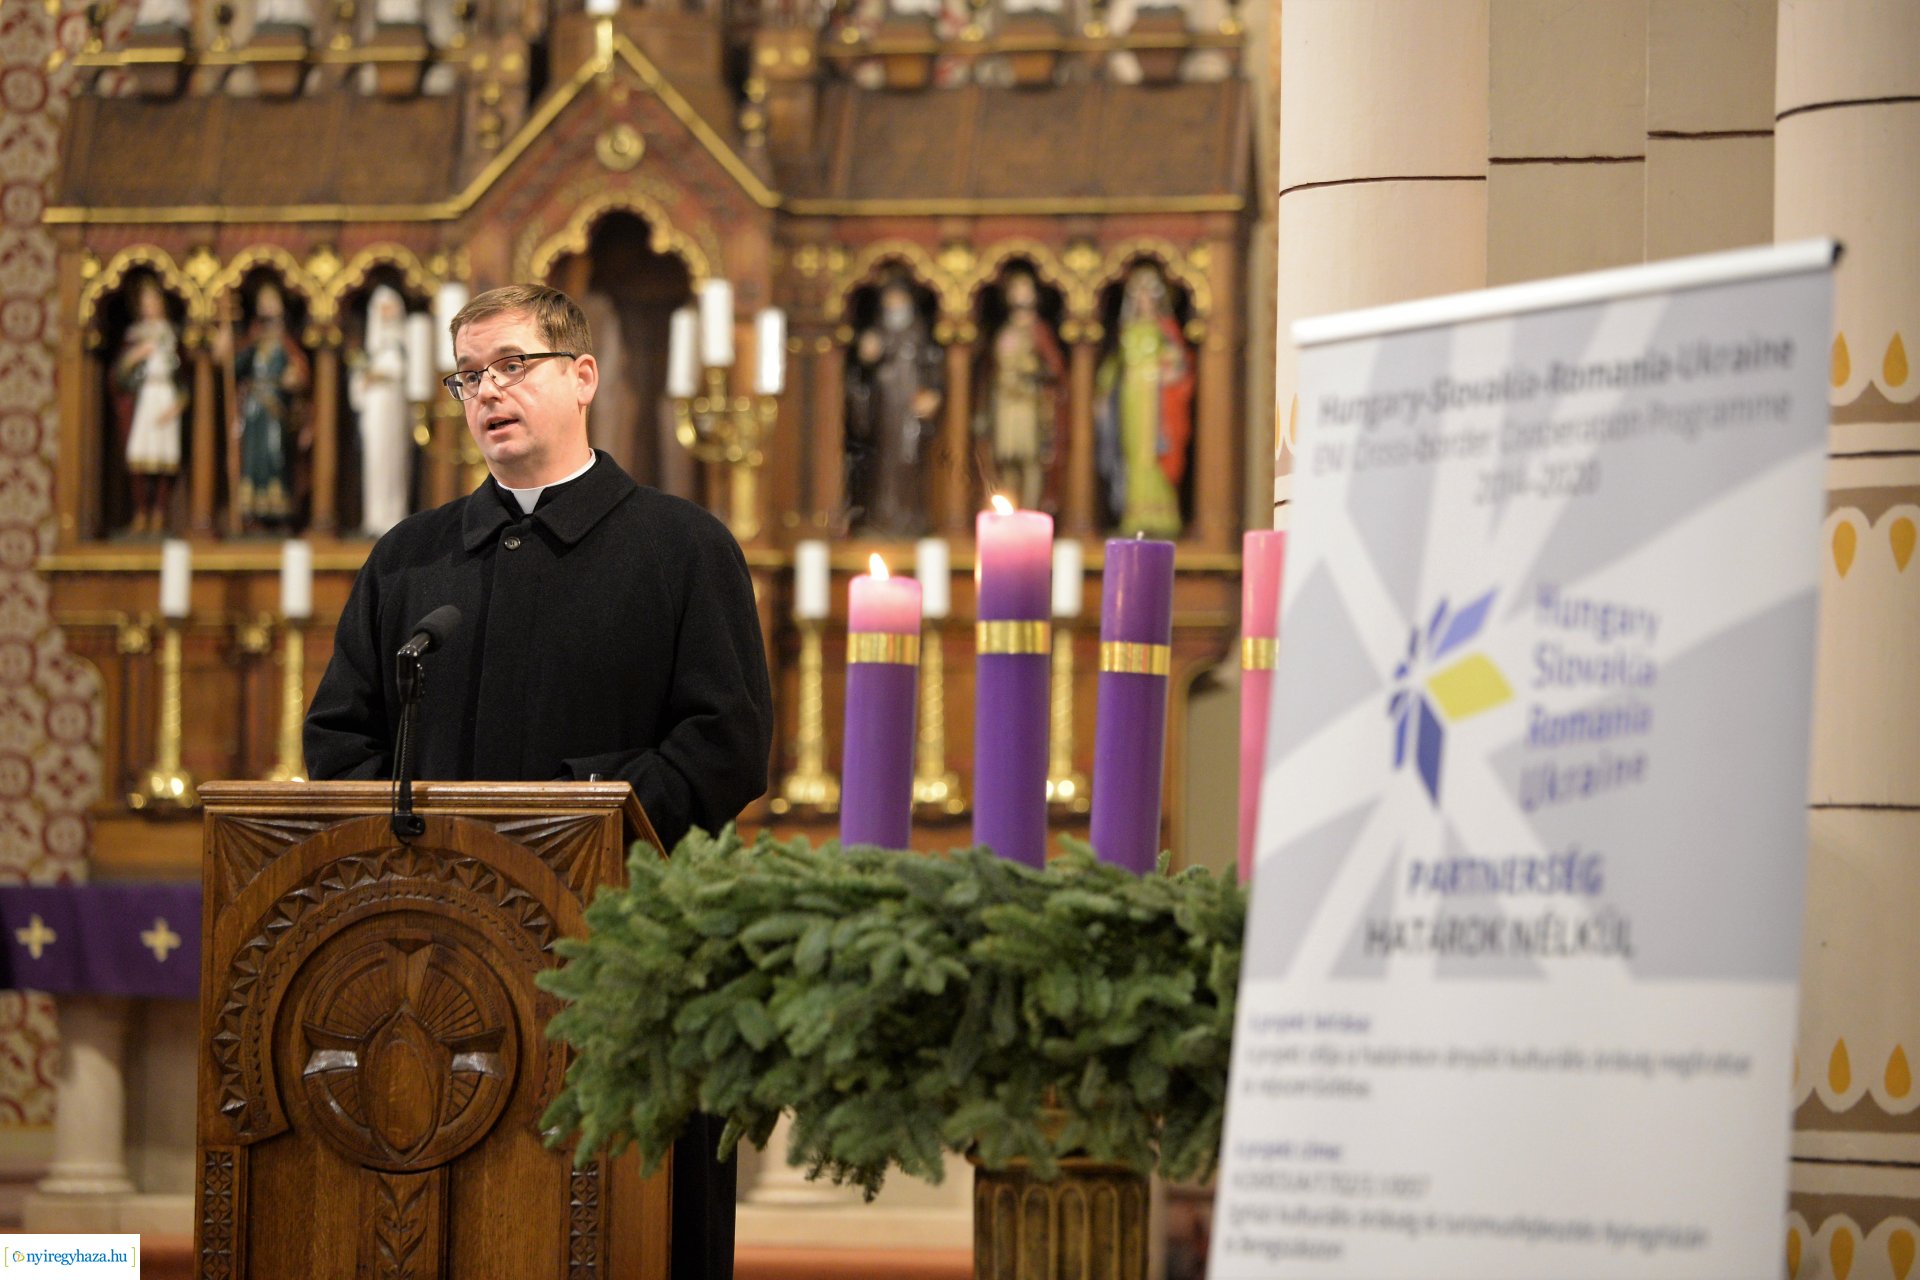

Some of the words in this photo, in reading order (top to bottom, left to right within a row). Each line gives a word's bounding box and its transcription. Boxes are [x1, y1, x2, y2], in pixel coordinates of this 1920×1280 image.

[1536, 583, 1660, 642] Hungary
[1531, 642, 1656, 689] Slovakia
[1527, 702, 1652, 749] Romania
[1520, 749, 1647, 812] Ukraine
